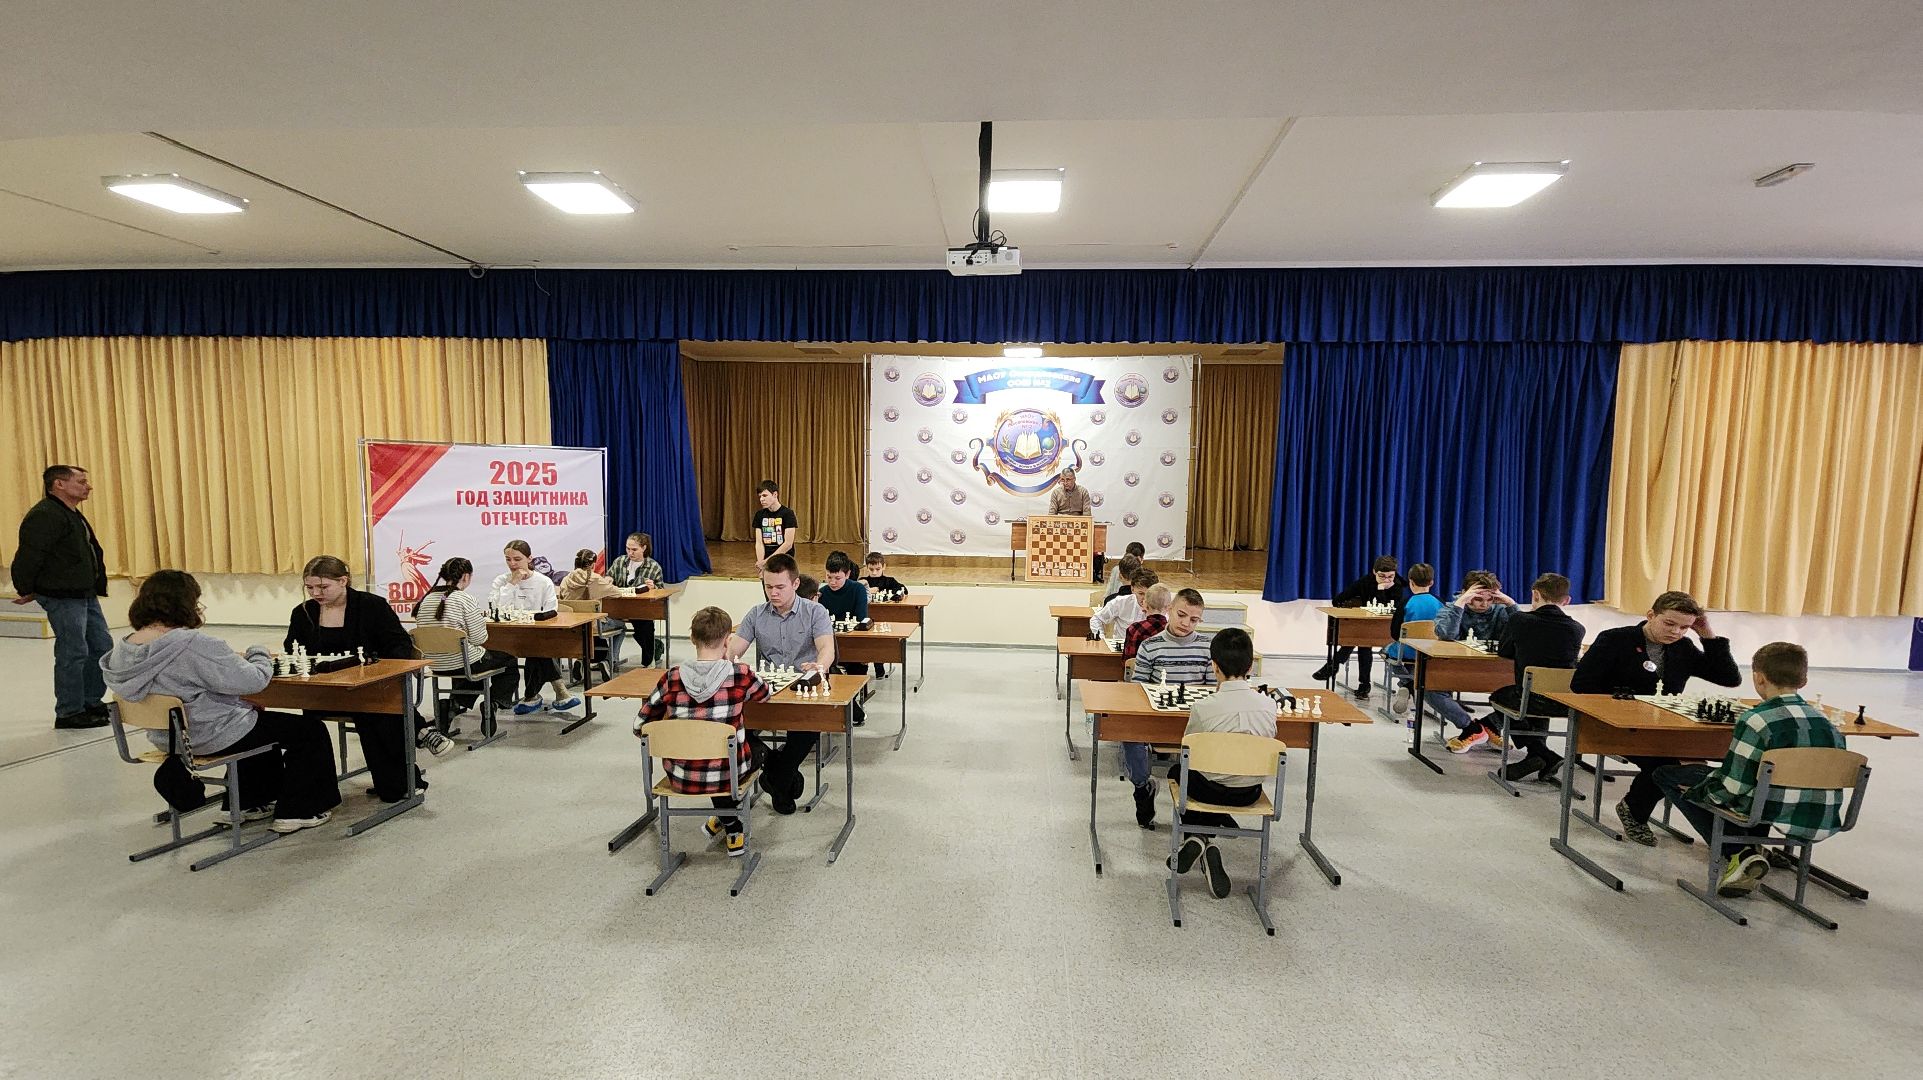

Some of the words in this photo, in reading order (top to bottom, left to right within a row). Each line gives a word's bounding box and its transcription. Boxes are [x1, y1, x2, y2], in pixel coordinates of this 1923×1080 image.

[489, 460, 558, 486] 2025
[456, 490, 489, 507] ГОД
[493, 490, 589, 508] ЗАЩИТНИКА
[481, 511, 569, 526] ОТЕЧЕСТВА
[388, 582, 415, 600] 80
[390, 603, 415, 614] ПОБ
